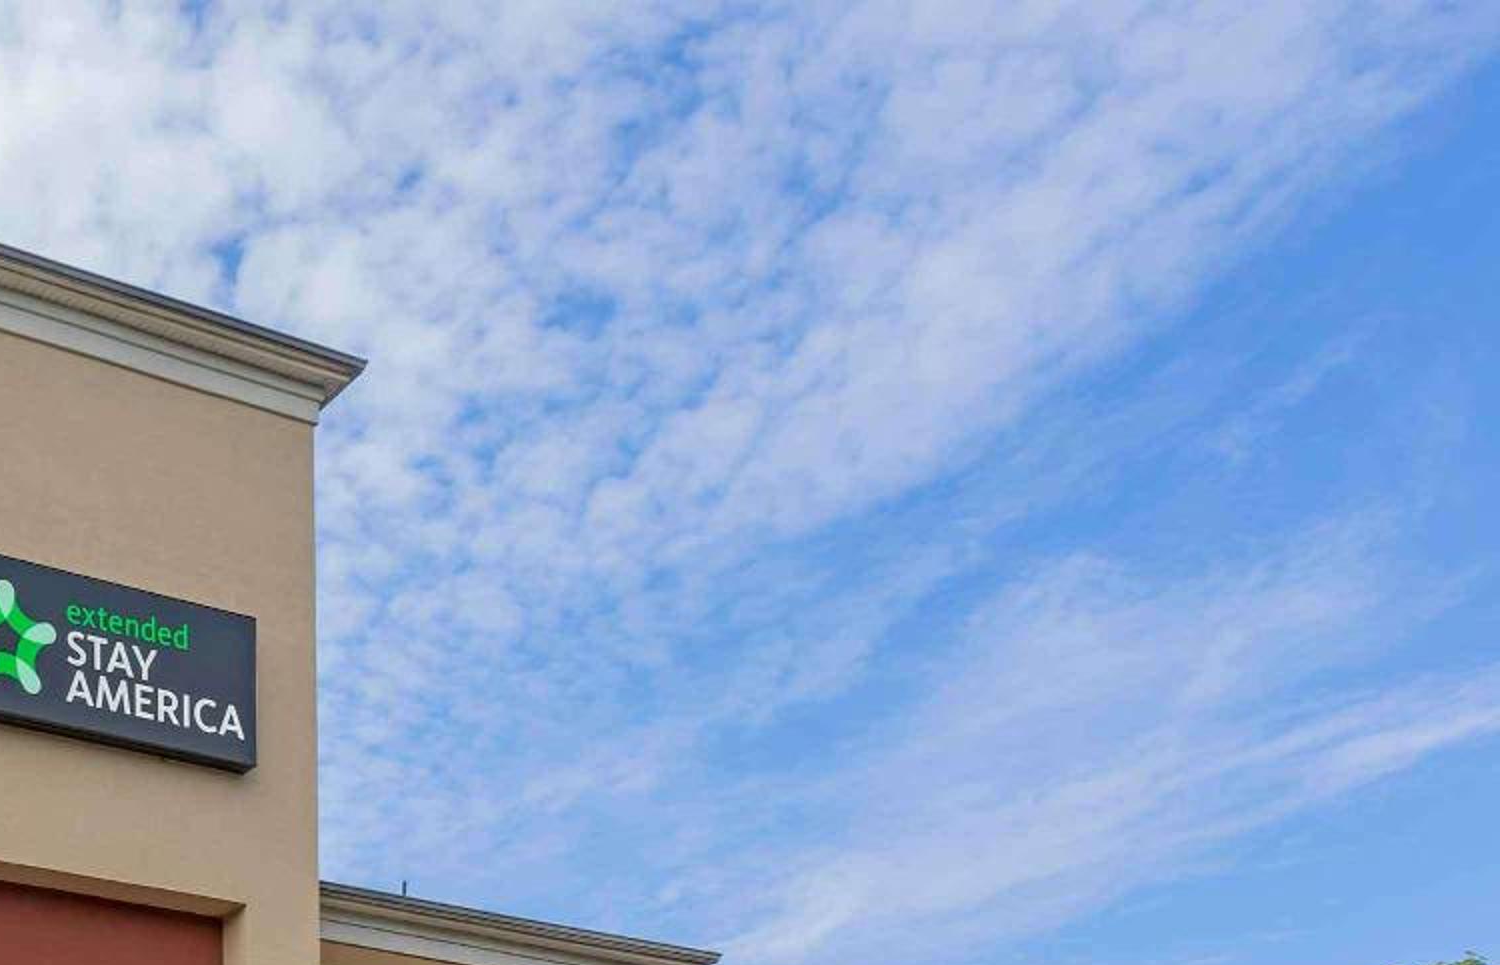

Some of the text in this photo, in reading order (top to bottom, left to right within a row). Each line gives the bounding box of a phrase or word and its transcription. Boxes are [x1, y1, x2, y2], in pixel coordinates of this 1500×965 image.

[66, 604, 189, 649] extended
[67, 631, 157, 680] STAY
[65, 670, 245, 741] AMERICA
